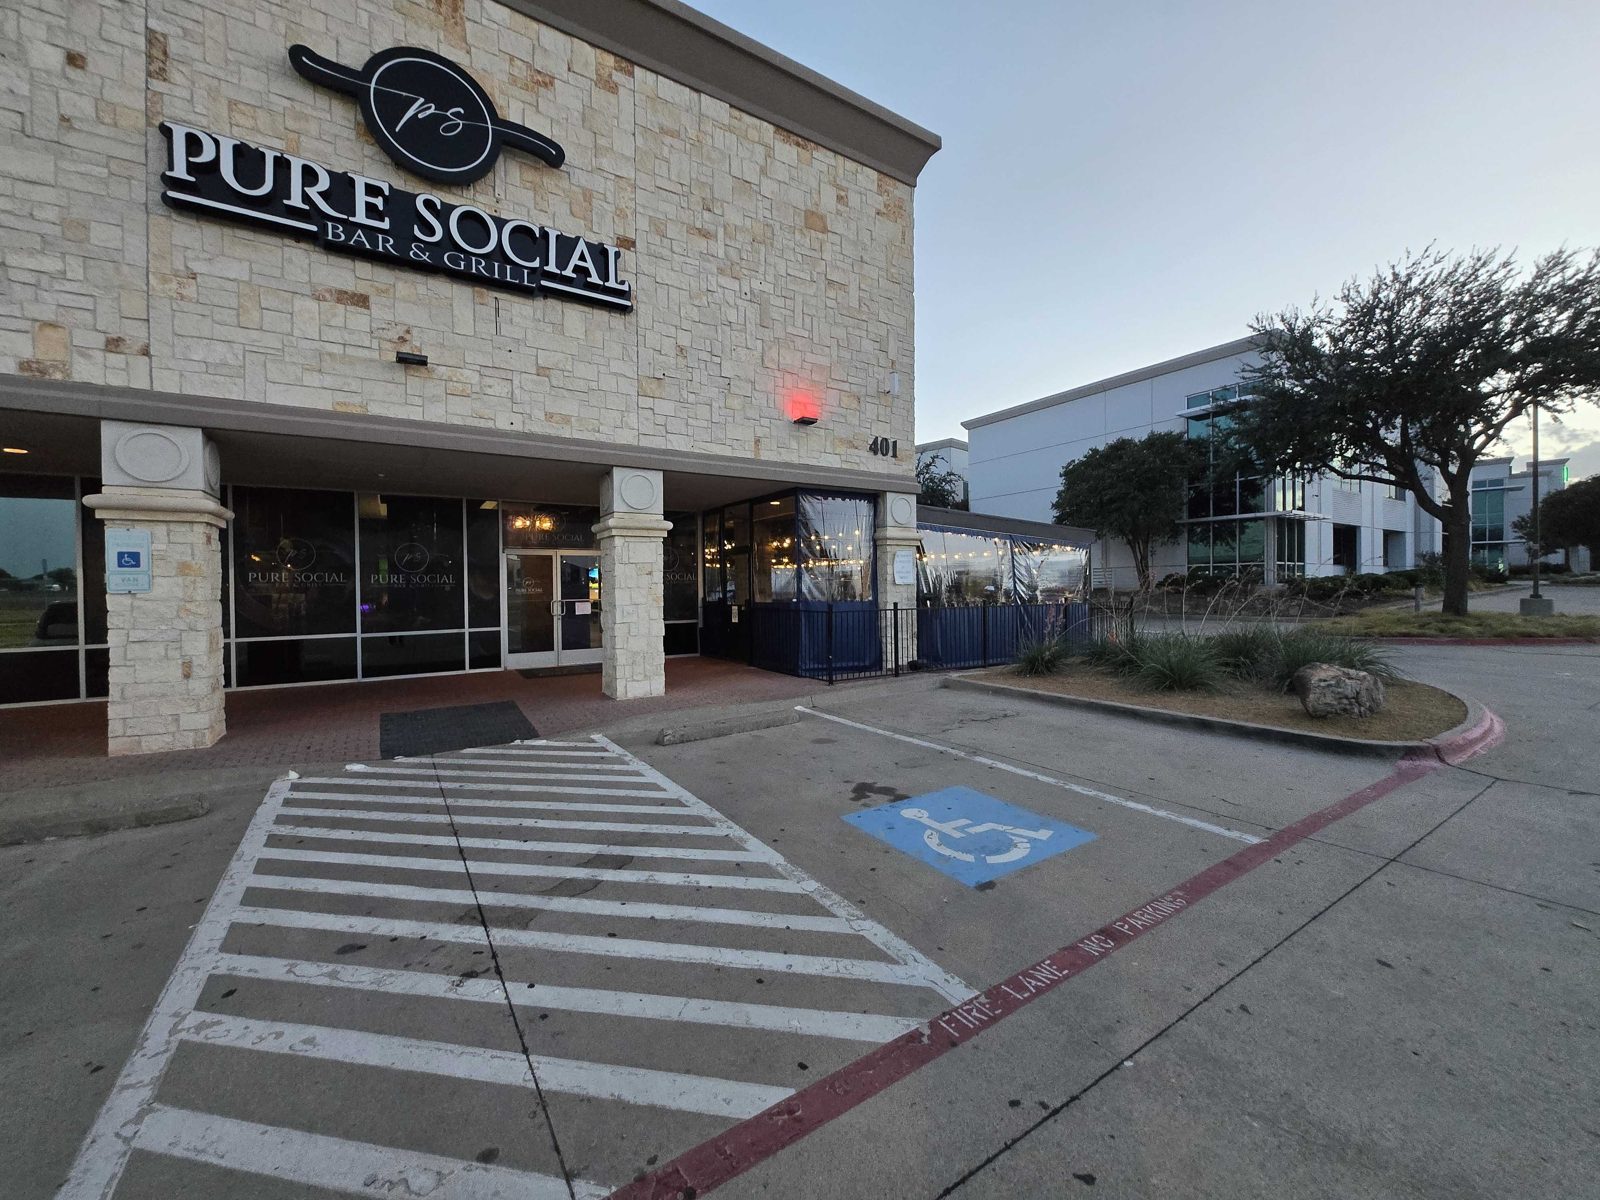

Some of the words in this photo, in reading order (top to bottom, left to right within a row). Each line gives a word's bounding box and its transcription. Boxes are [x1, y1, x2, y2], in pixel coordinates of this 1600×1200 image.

[164, 121, 390, 230] PURE
[413, 192, 630, 291] SOCIAL
[325, 221, 400, 256] BAR
[409, 243, 431, 263] &
[443, 251, 537, 287] GRILL
[868, 436, 898, 459] 401
[248, 572, 289, 583] PURE
[294, 572, 347, 583] SOCIAL
[370, 574, 406, 584] PURE
[410, 574, 456, 584] SOCIAL
[666, 572, 697, 581] SOCIAL
[938, 1001, 1002, 1037] FIRE
[1001, 960, 1070, 1000] LANE
[1077, 933, 1115, 957] NO
[1112, 894, 1188, 936] PARKING
